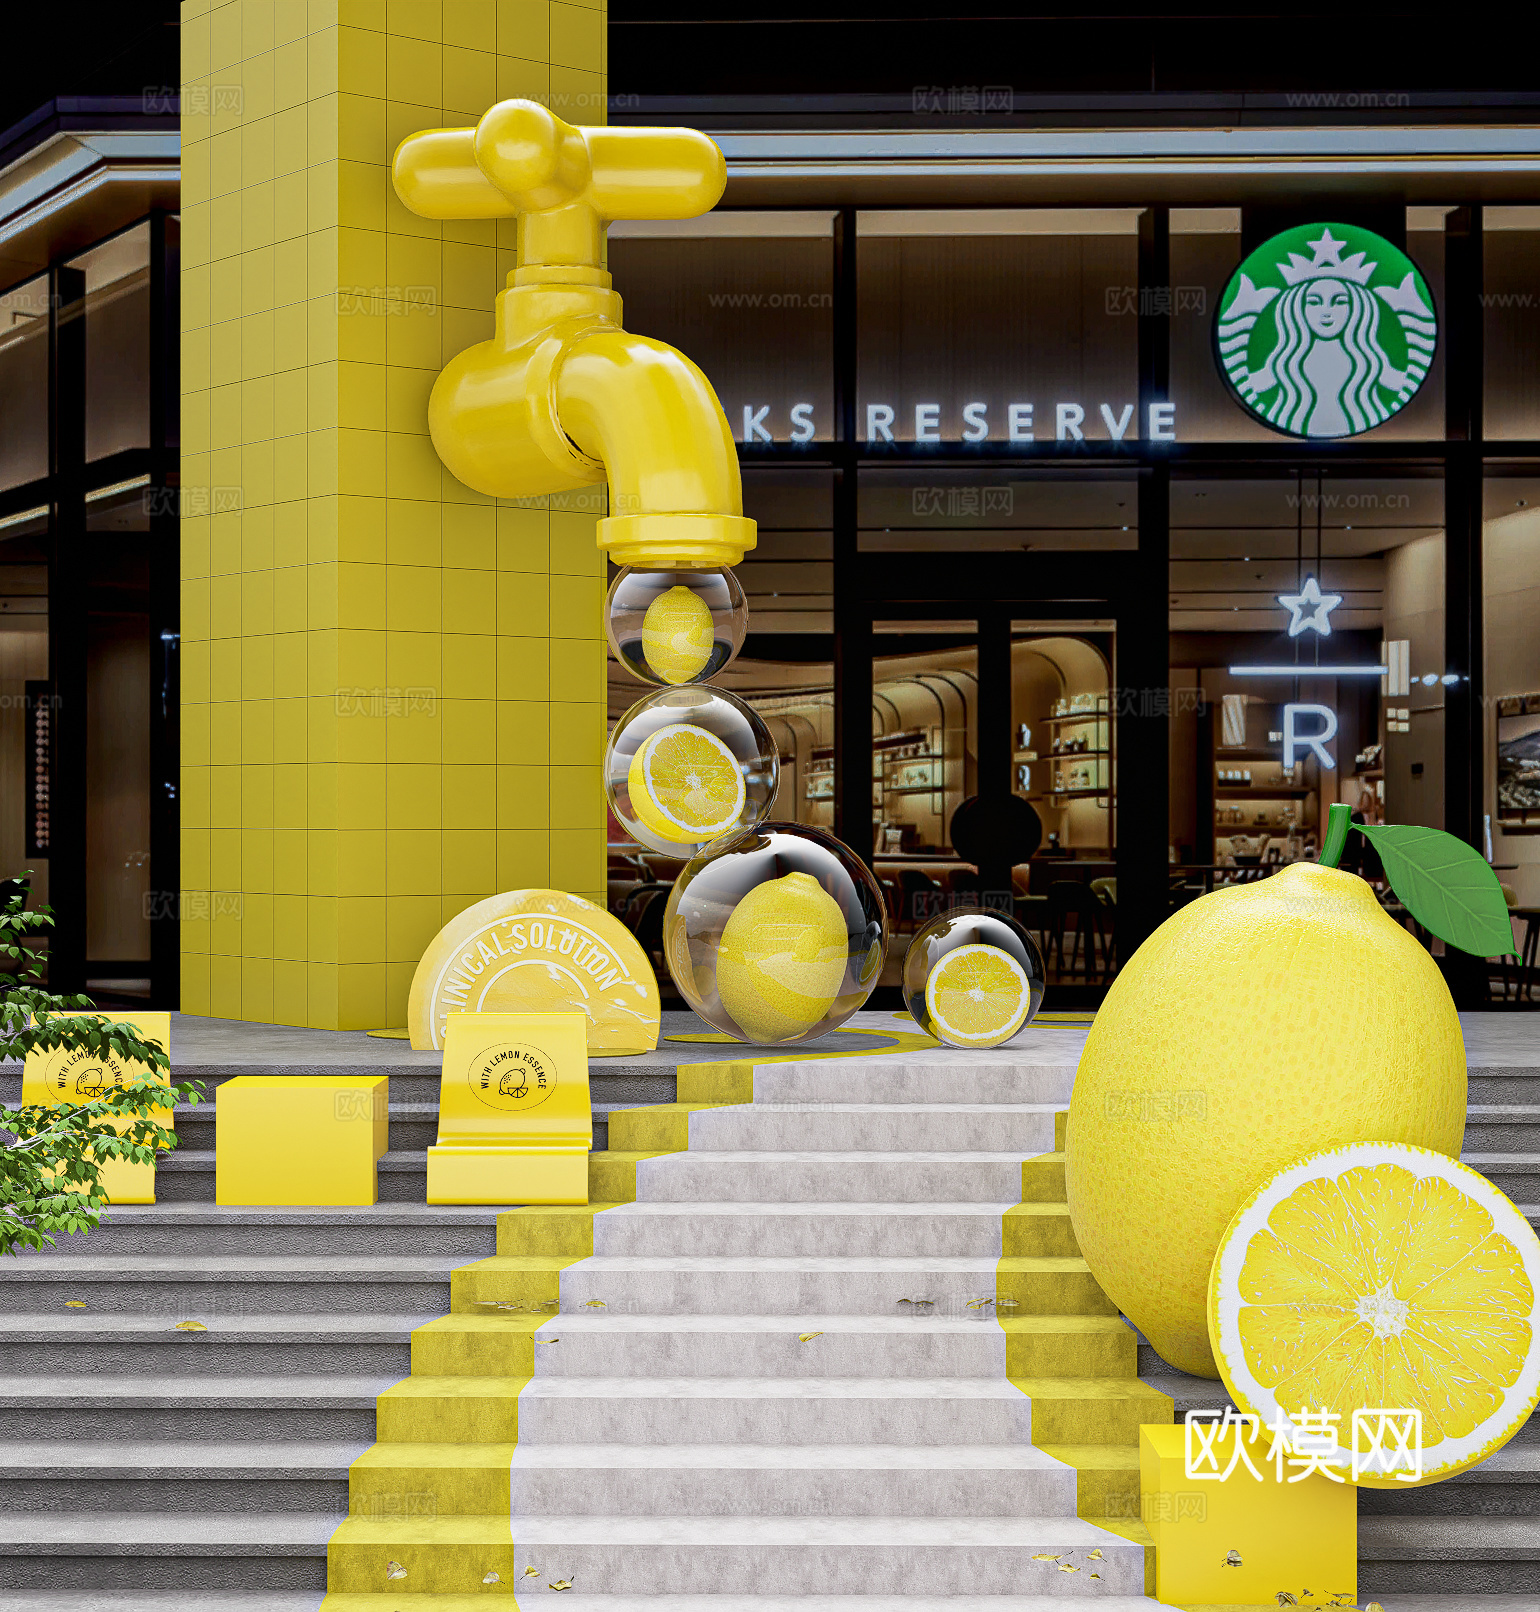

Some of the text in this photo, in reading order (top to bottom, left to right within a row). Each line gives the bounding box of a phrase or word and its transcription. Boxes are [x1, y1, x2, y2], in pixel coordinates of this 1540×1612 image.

[866, 403, 1176, 442] RESERVE
[1283, 703, 1338, 769] R
[511, 922, 623, 992] SOLUTION
[57, 1065, 70, 1089] WITH
[104, 1055, 124, 1086] SSENC
[480, 1050, 547, 1090] WITH LEMON ESSENCE
